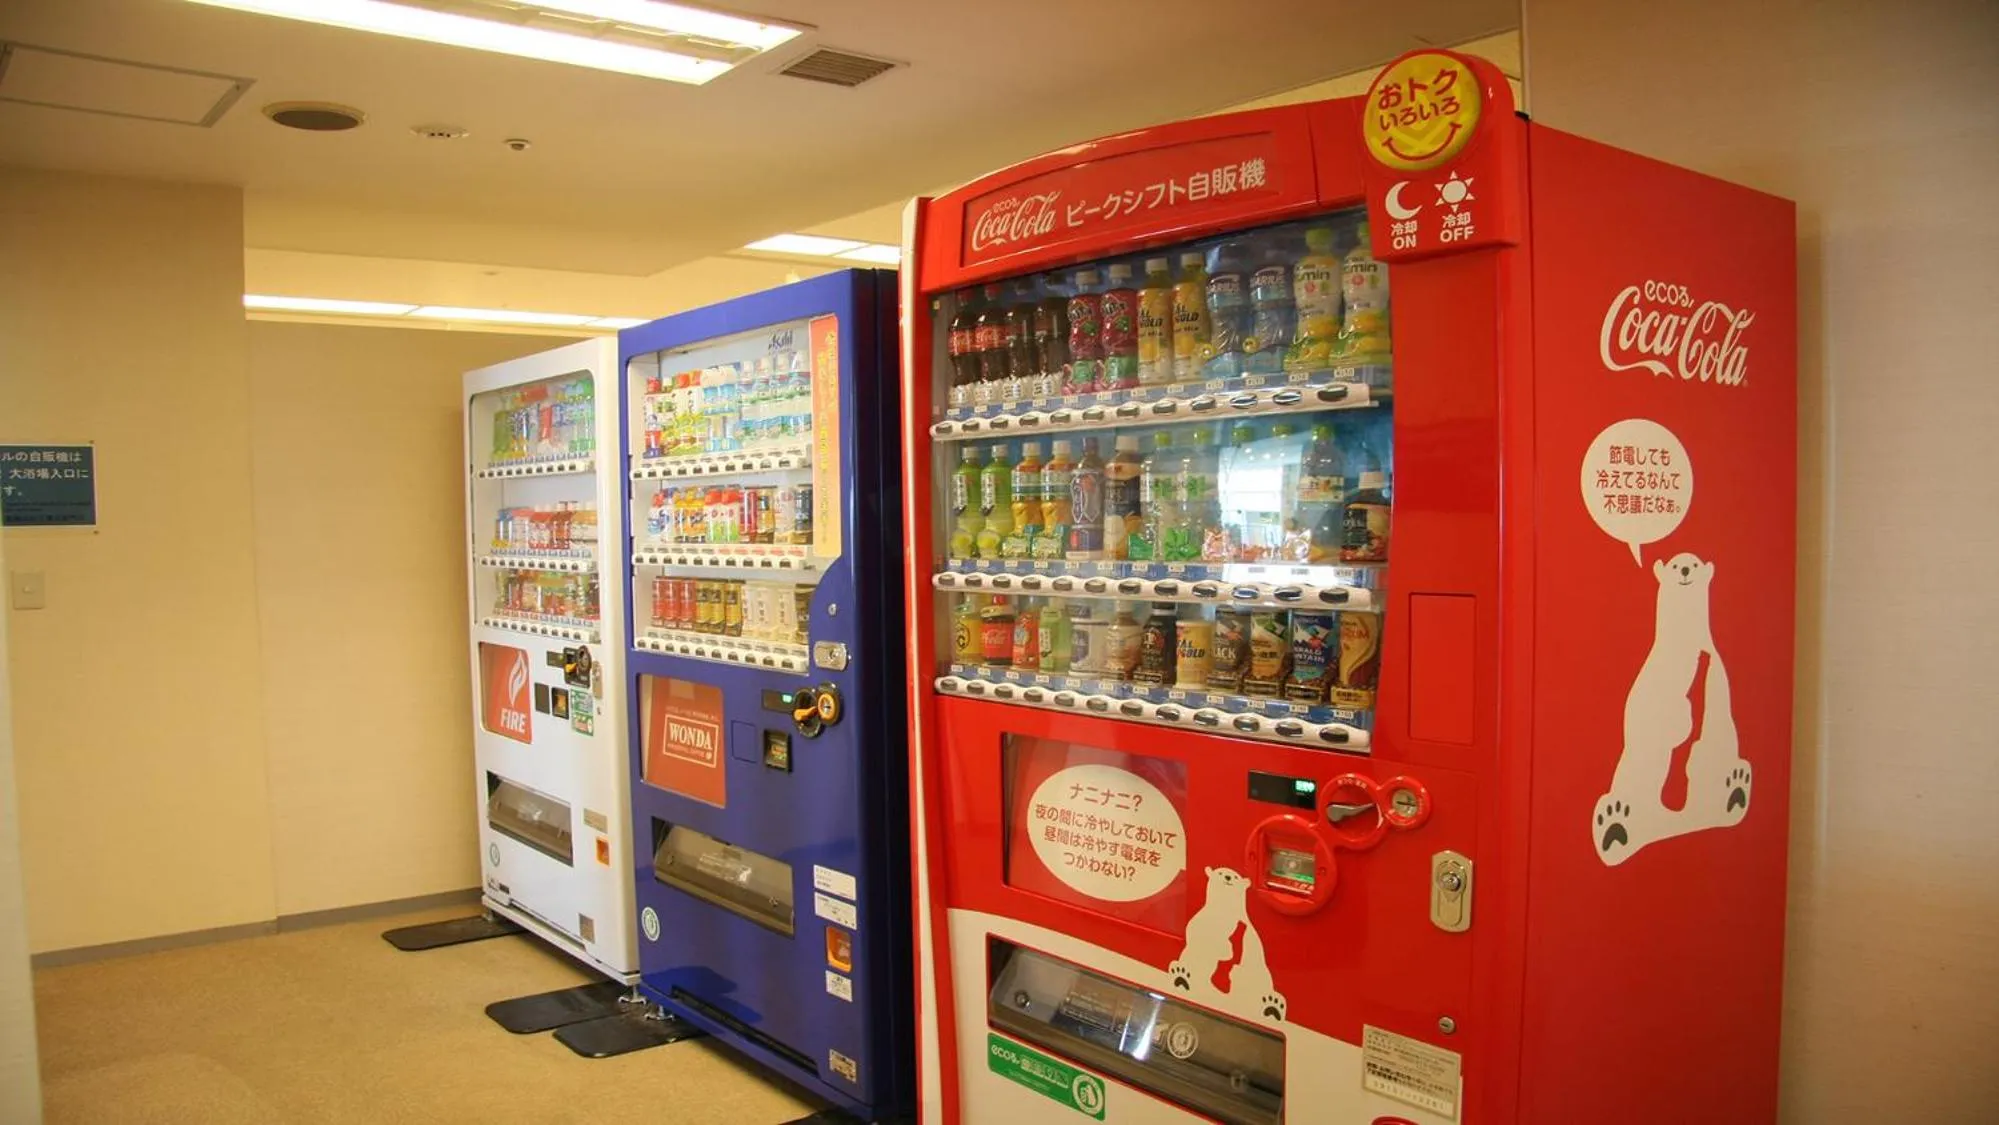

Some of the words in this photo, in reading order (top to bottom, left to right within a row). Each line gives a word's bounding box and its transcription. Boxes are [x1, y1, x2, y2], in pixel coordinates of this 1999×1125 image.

[1378, 69, 1458, 110] おトク
[1379, 96, 1460, 130] いろいろ
[1066, 158, 1266, 228] ピークシフト自販機
[972, 189, 1062, 251] Coca-Cola
[1391, 220, 1418, 237] 冷却
[1440, 226, 1475, 242] OFF
[1442, 212, 1471, 228] 冷却
[1393, 235, 1417, 250] ON
[1600, 285, 1756, 387] Coca-Cola
[1609, 446, 1671, 467] 節電しても
[1596, 470, 1681, 491] 冷えてるなんて
[500, 707, 527, 735] FIRE
[669, 722, 713, 750] WONDA
[1070, 782, 1144, 812] ナニナニ?
[1034, 803, 1178, 849] 夜の間に冷やしておいて
[1044, 825, 1162, 868] 昼間は冷やす電気を
[1063, 851, 1137, 883] つかわない?
